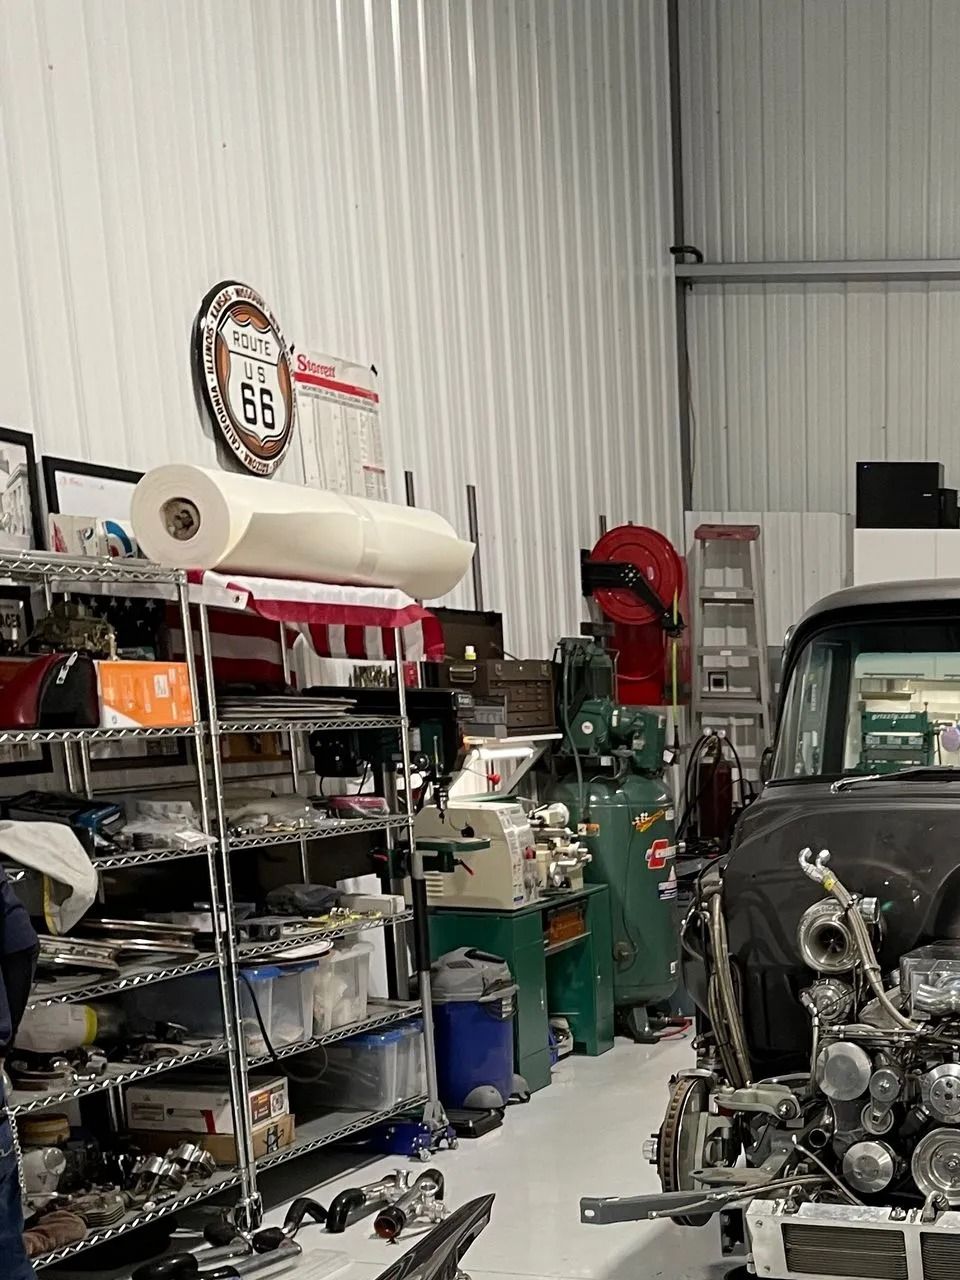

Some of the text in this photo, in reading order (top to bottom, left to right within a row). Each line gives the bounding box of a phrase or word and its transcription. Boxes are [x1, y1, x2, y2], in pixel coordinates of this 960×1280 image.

[203, 324, 215, 375] ILLINOIS
[209, 290, 232, 319] KANSAS
[232, 330, 272, 356] ROUTE
[297, 353, 336, 378] Starrett
[209, 385, 241, 451] CALIFORNIA
[240, 382, 276, 430] 66
